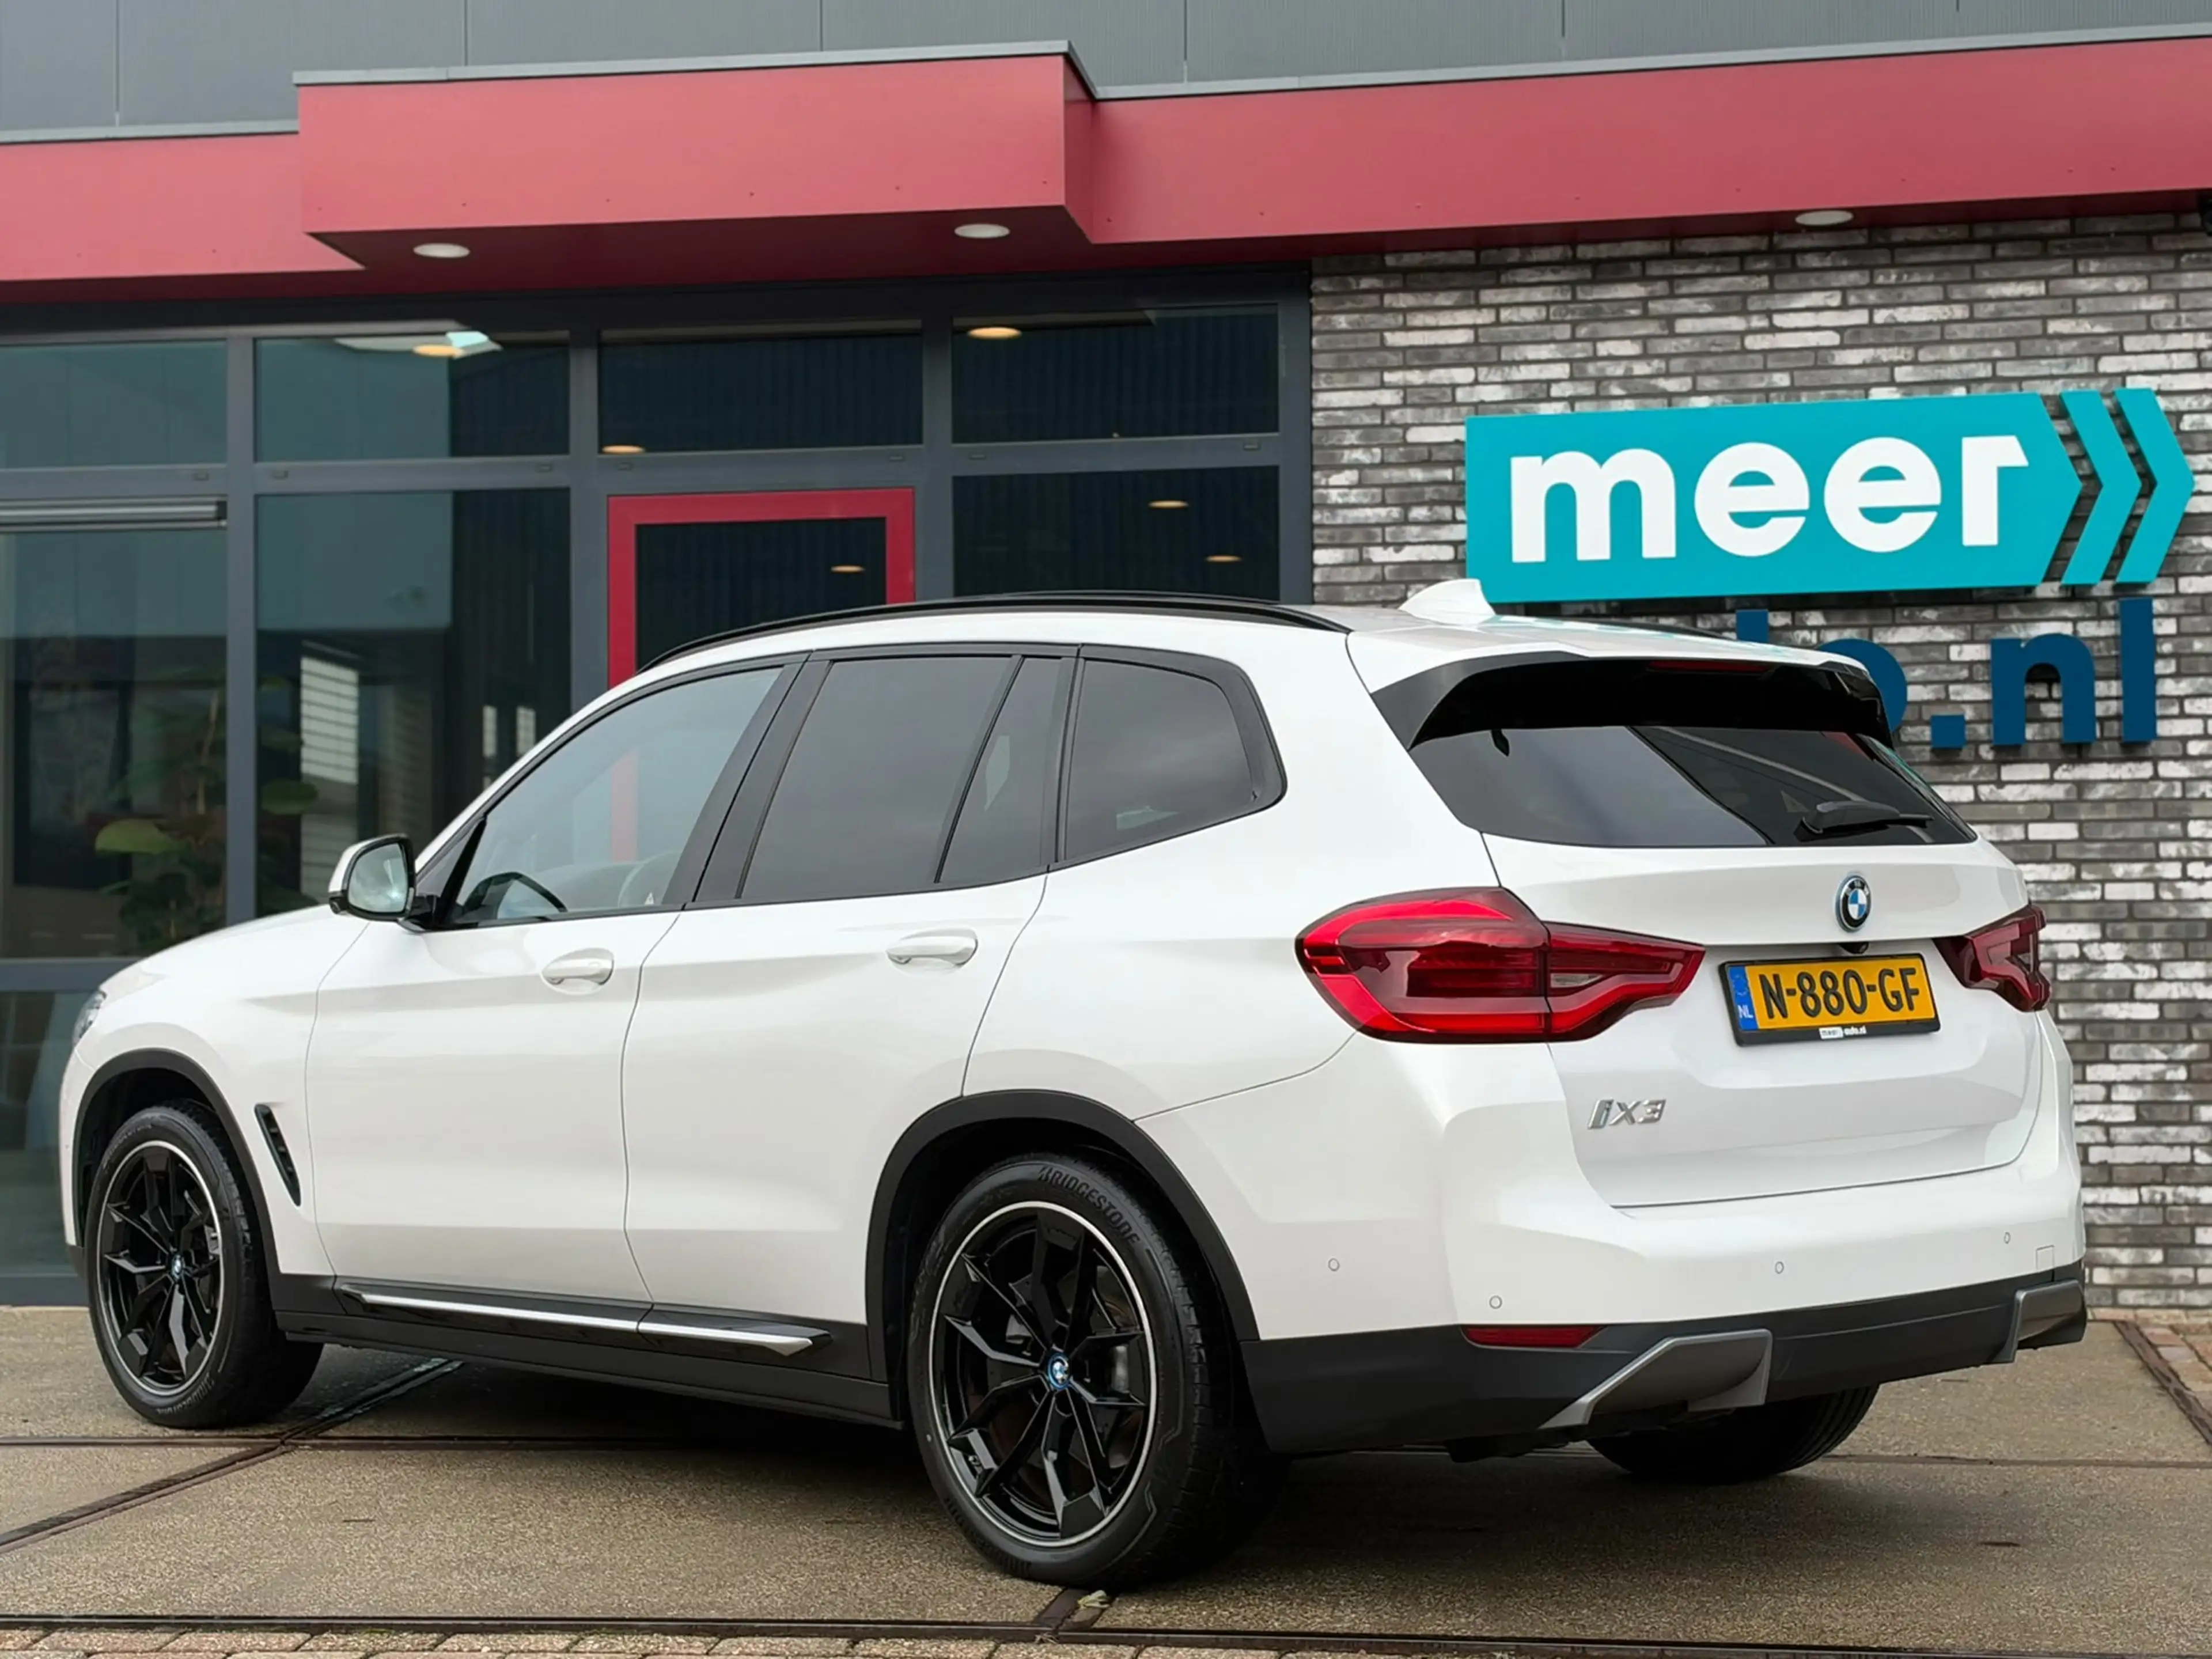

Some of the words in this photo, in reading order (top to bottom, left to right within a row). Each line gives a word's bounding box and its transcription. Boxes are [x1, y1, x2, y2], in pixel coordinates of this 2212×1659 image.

[1510, 435, 2029, 563] meer
[1737, 1005, 1753, 1019] NL
[1759, 967, 1920, 1020] N-880-GF
[1038, 1166, 1141, 1244] BRIDGESTONE
